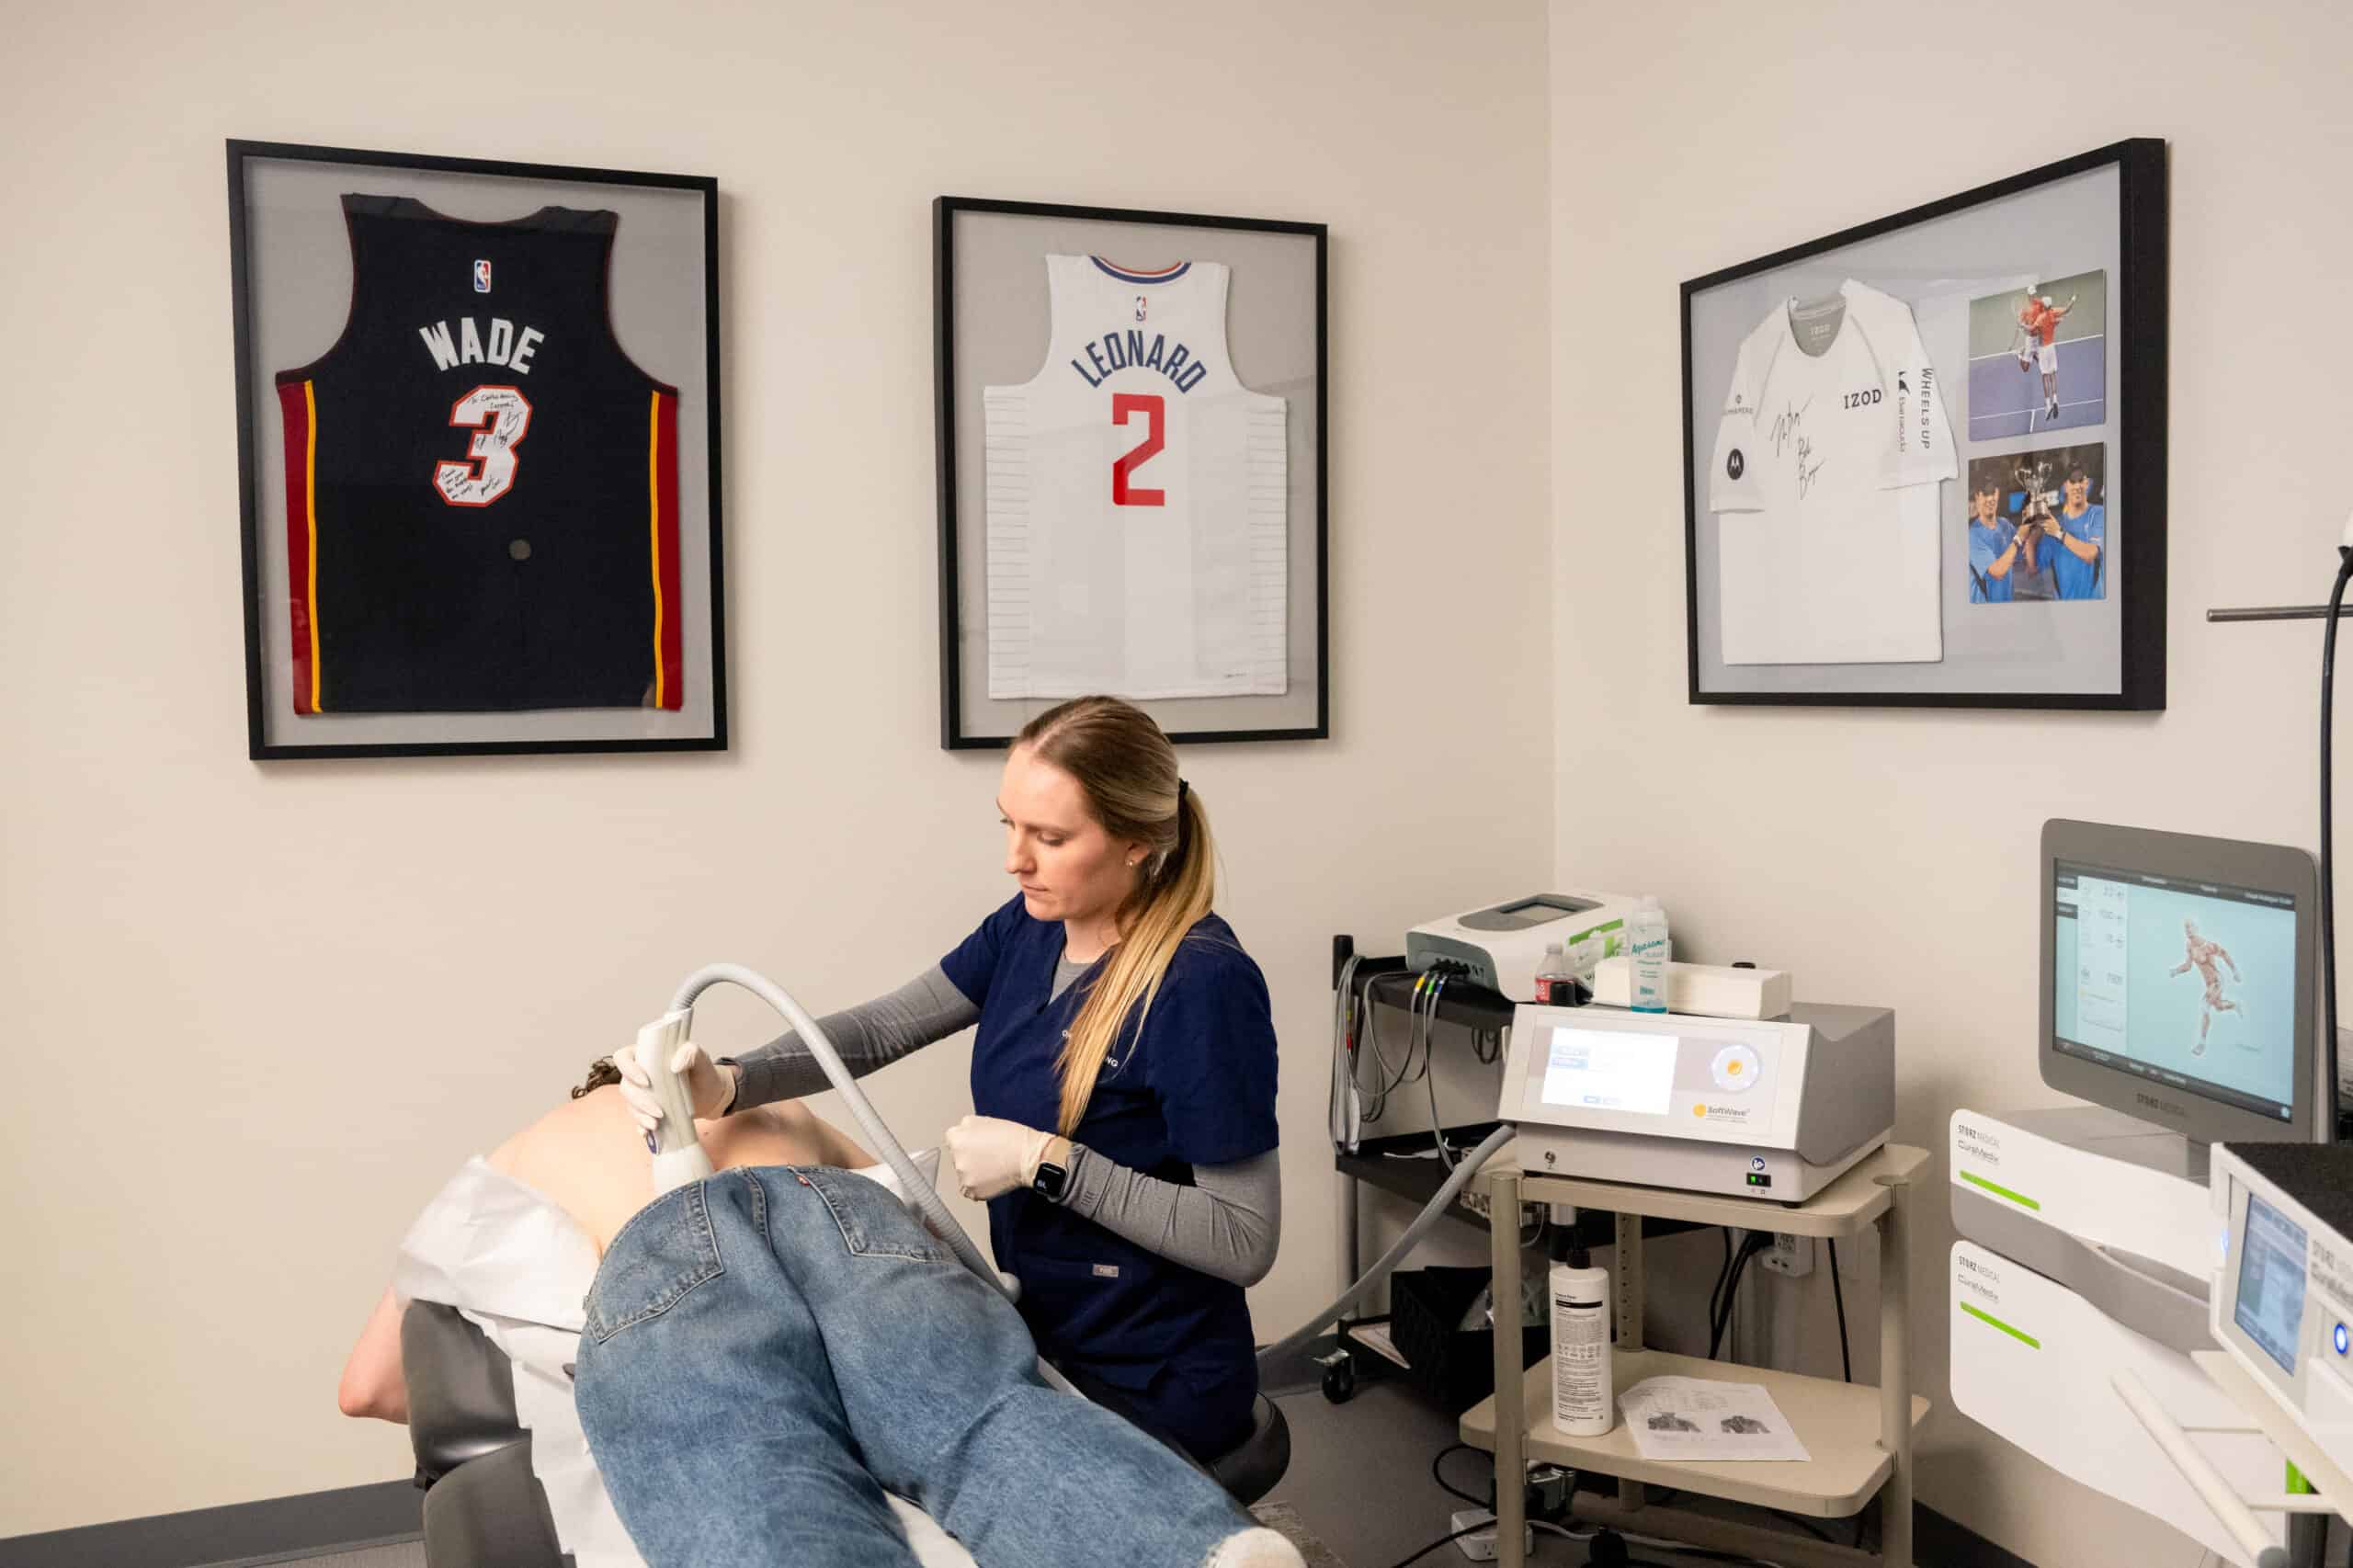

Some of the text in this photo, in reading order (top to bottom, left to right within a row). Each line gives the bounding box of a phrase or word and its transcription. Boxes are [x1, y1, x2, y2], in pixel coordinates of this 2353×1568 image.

[419, 317, 545, 375] WADE
[1071, 329, 1207, 393] LEONARD
[1844, 389, 1882, 410] IZOD
[1919, 368, 1934, 449] WHEELS UP
[432, 384, 532, 507] 3
[1112, 392, 1165, 506] 2
